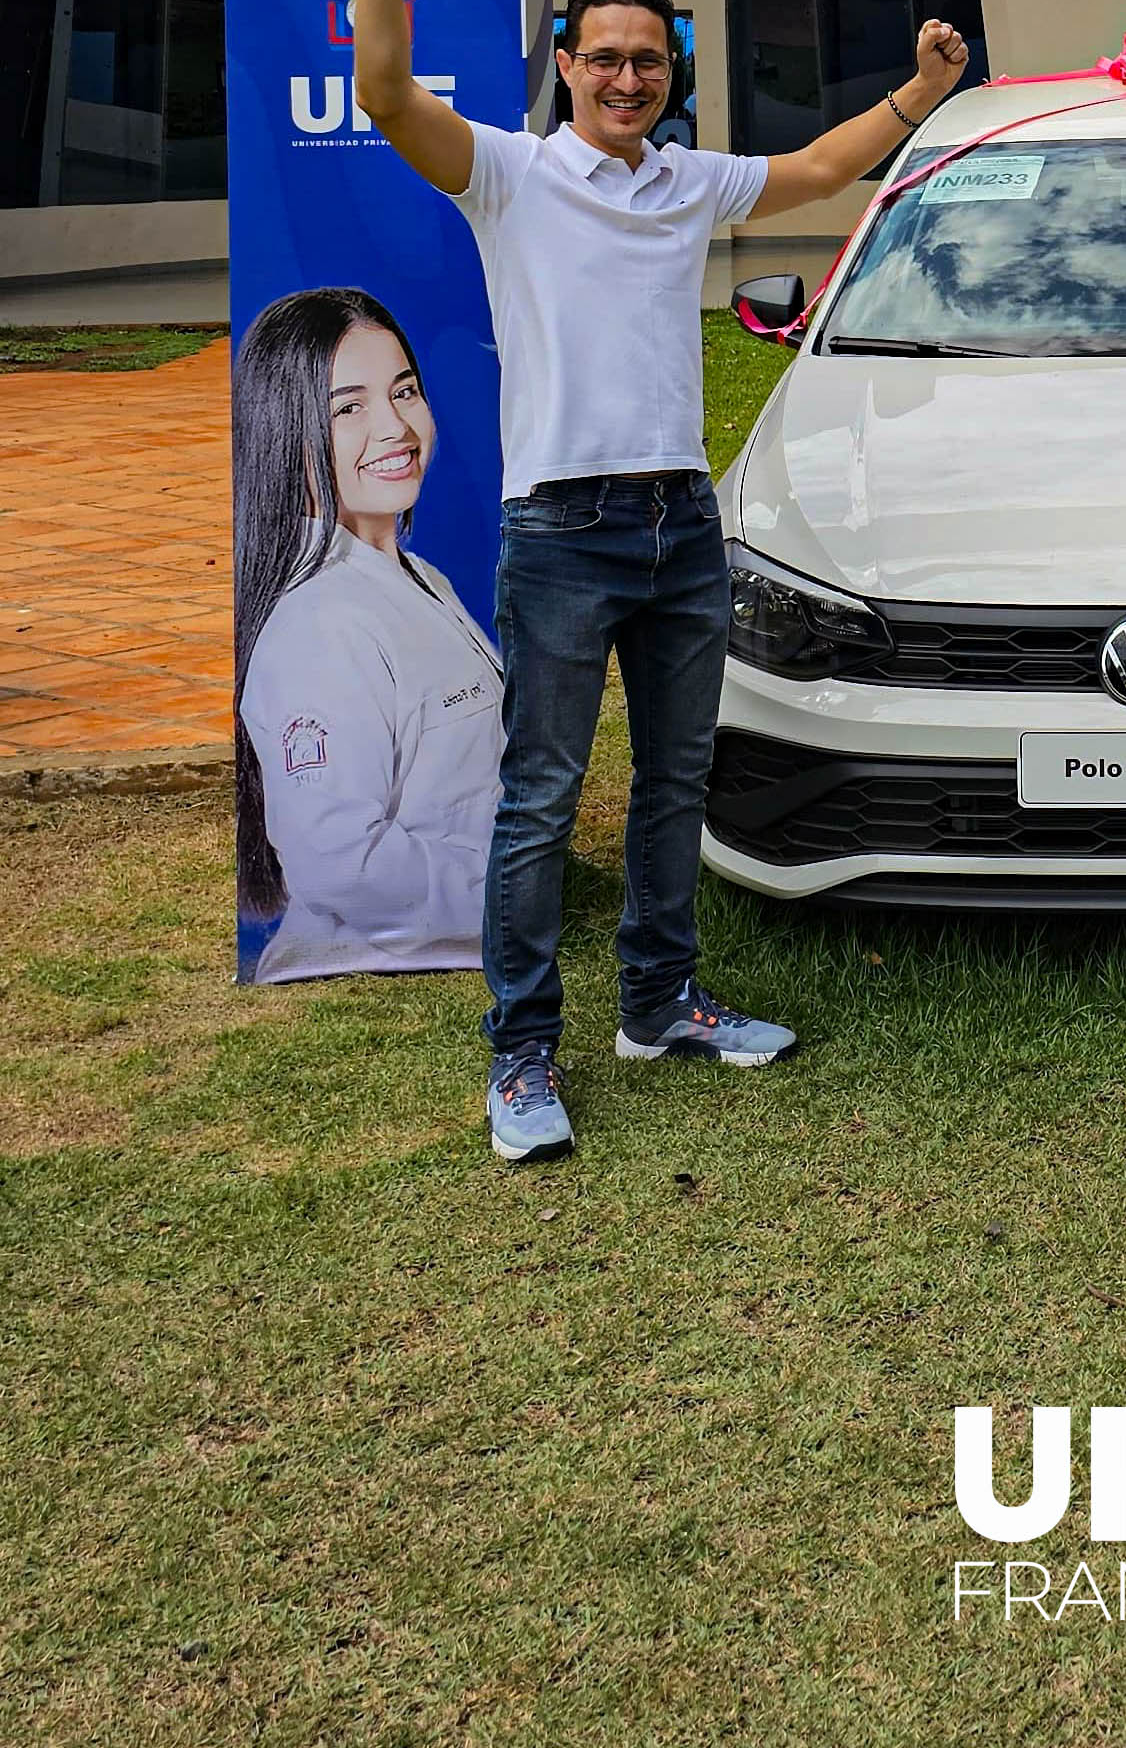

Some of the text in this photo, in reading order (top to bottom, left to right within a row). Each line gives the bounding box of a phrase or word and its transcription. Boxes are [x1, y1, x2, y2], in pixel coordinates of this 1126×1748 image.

[291, 139, 359, 148] UNIVERSIDAD
[932, 173, 1029, 189] INM233
[1065, 758, 1123, 778] Polo
